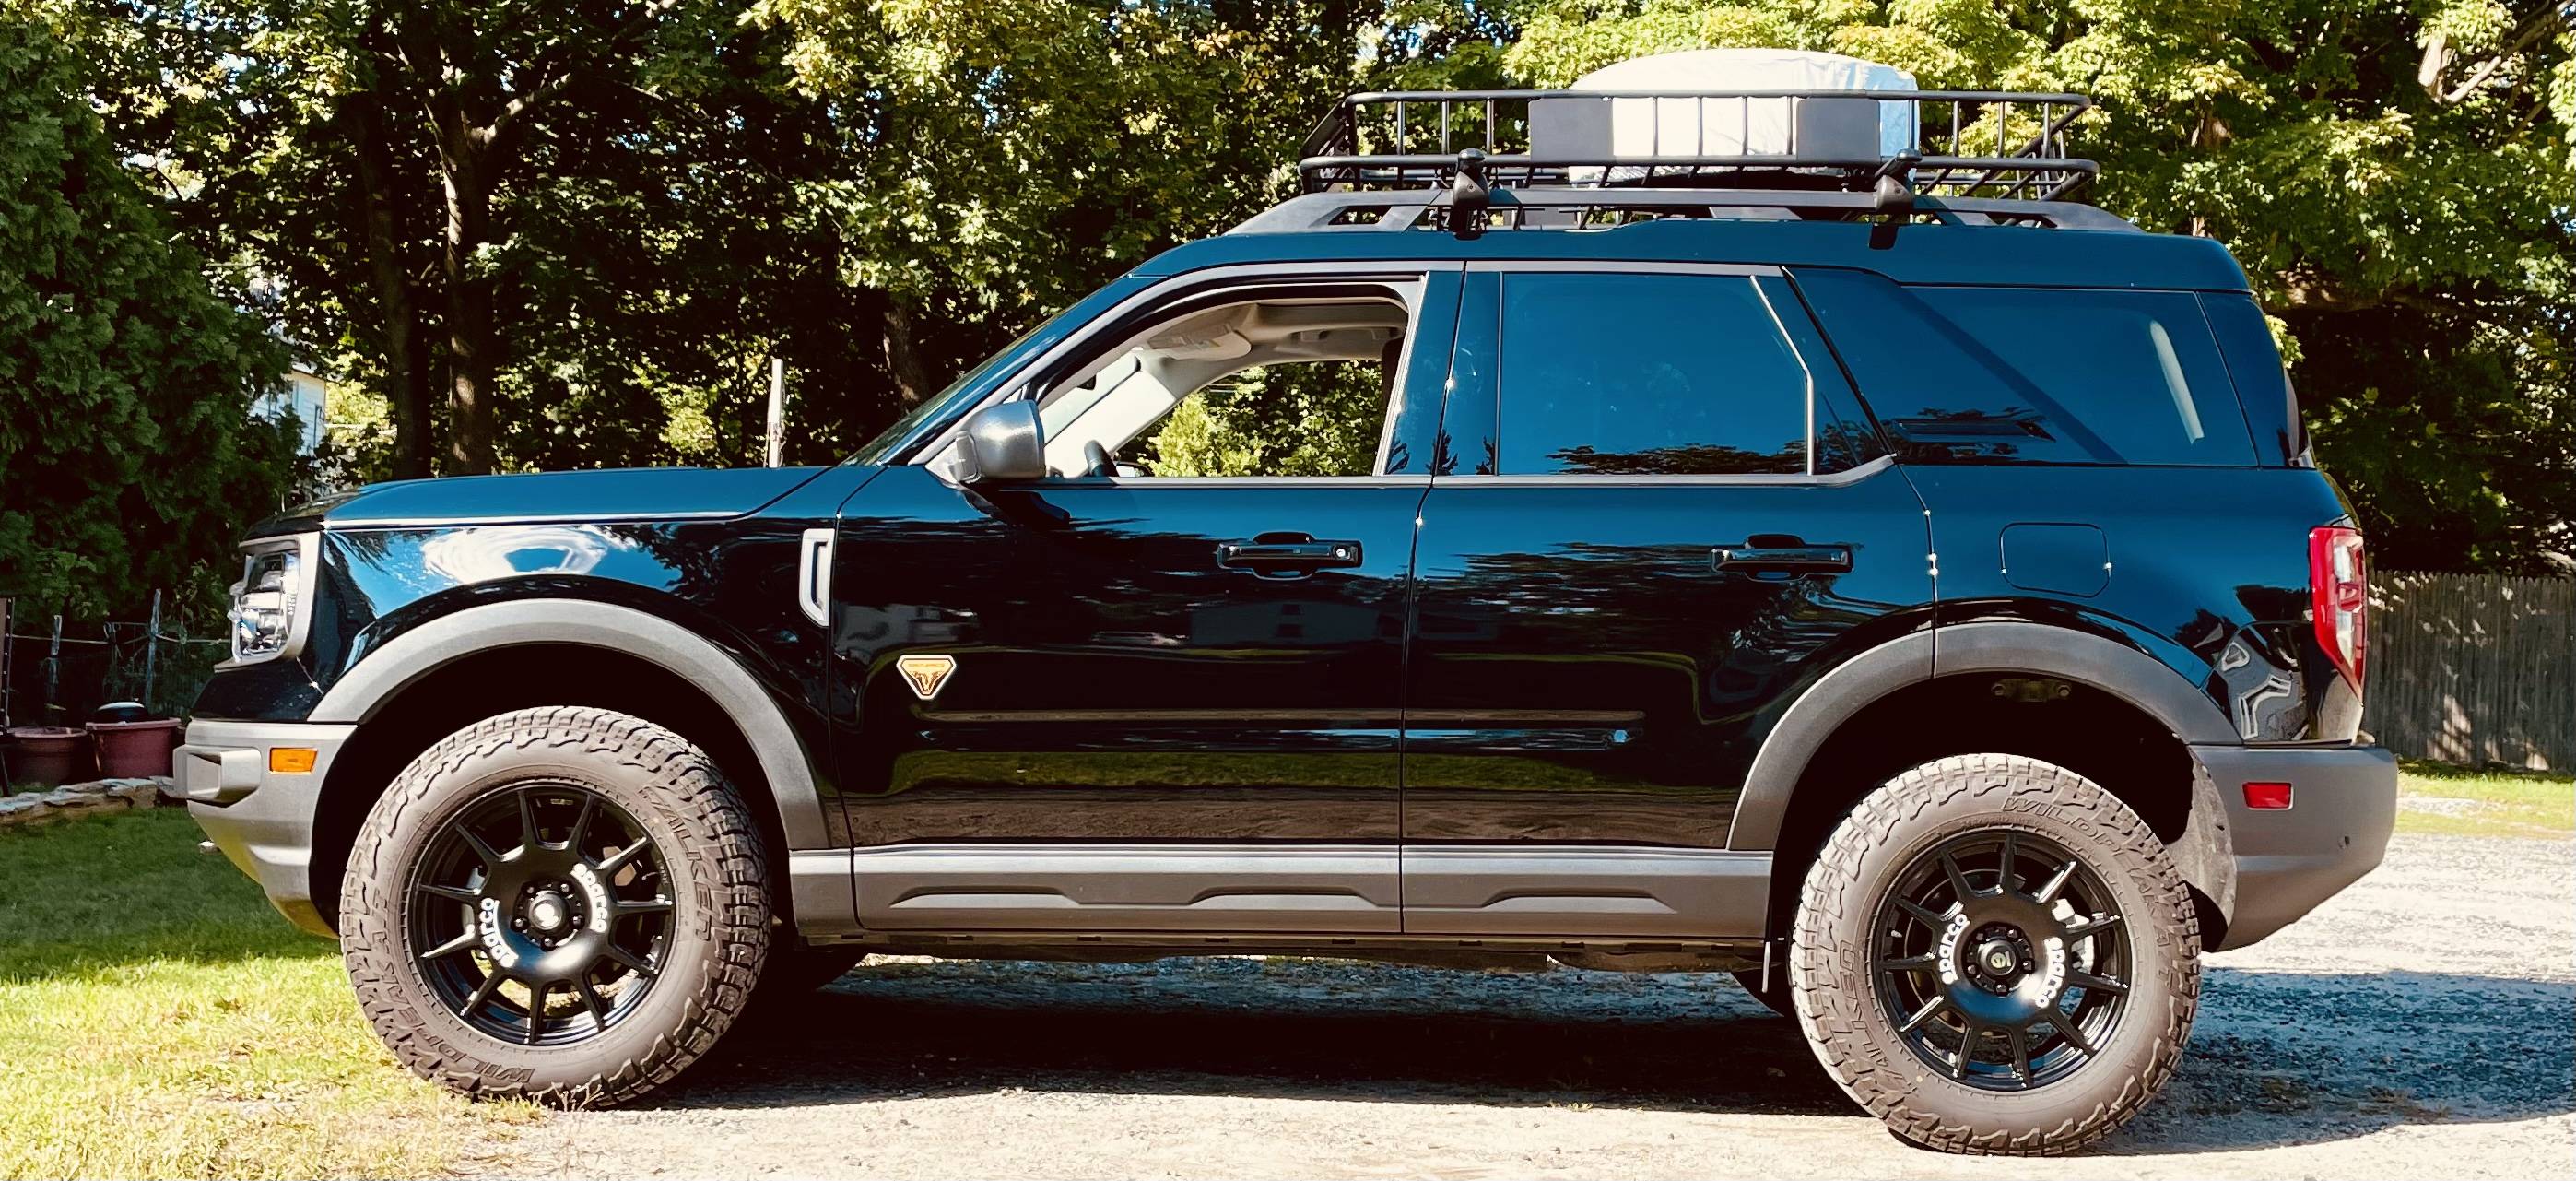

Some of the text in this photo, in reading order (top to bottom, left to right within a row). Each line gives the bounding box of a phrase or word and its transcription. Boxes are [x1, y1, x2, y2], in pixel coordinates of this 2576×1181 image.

[479, 897, 519, 968] sparco
[570, 862, 608, 934] sparco
[1938, 913, 1970, 985] sparco
[2035, 936, 2066, 1009] sparco
